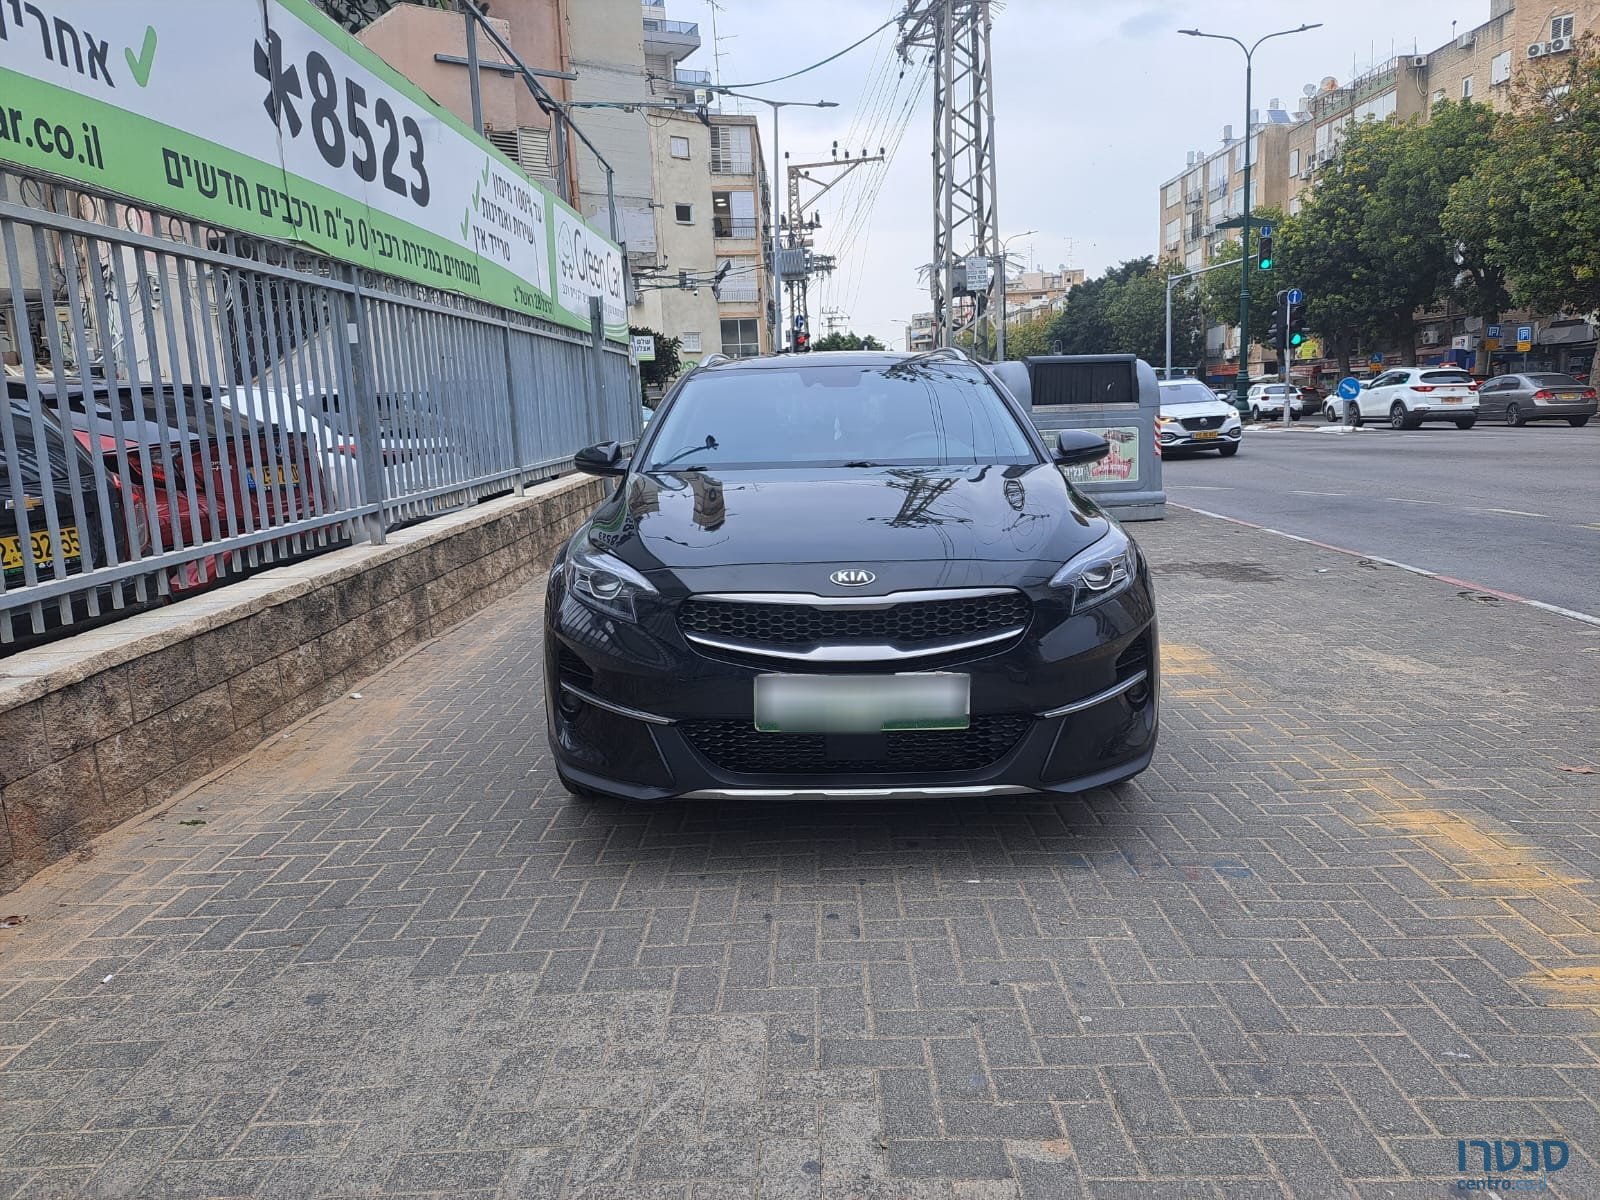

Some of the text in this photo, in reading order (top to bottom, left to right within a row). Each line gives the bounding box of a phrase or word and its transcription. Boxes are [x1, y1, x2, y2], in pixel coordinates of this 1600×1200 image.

[162, 147, 251, 211] חדשים
[492, 171, 542, 224] עד 100% מימון
[256, 183, 321, 234] ורכבים
[481, 196, 534, 245] שירות ואמינות
[371, 228, 401, 262] רכבי
[402, 239, 443, 274] במכירת
[473, 224, 510, 262] טרייד אין
[574, 228, 620, 298] Green Car
[443, 254, 481, 286] מתמחים
[837, 571, 869, 582] KIA
